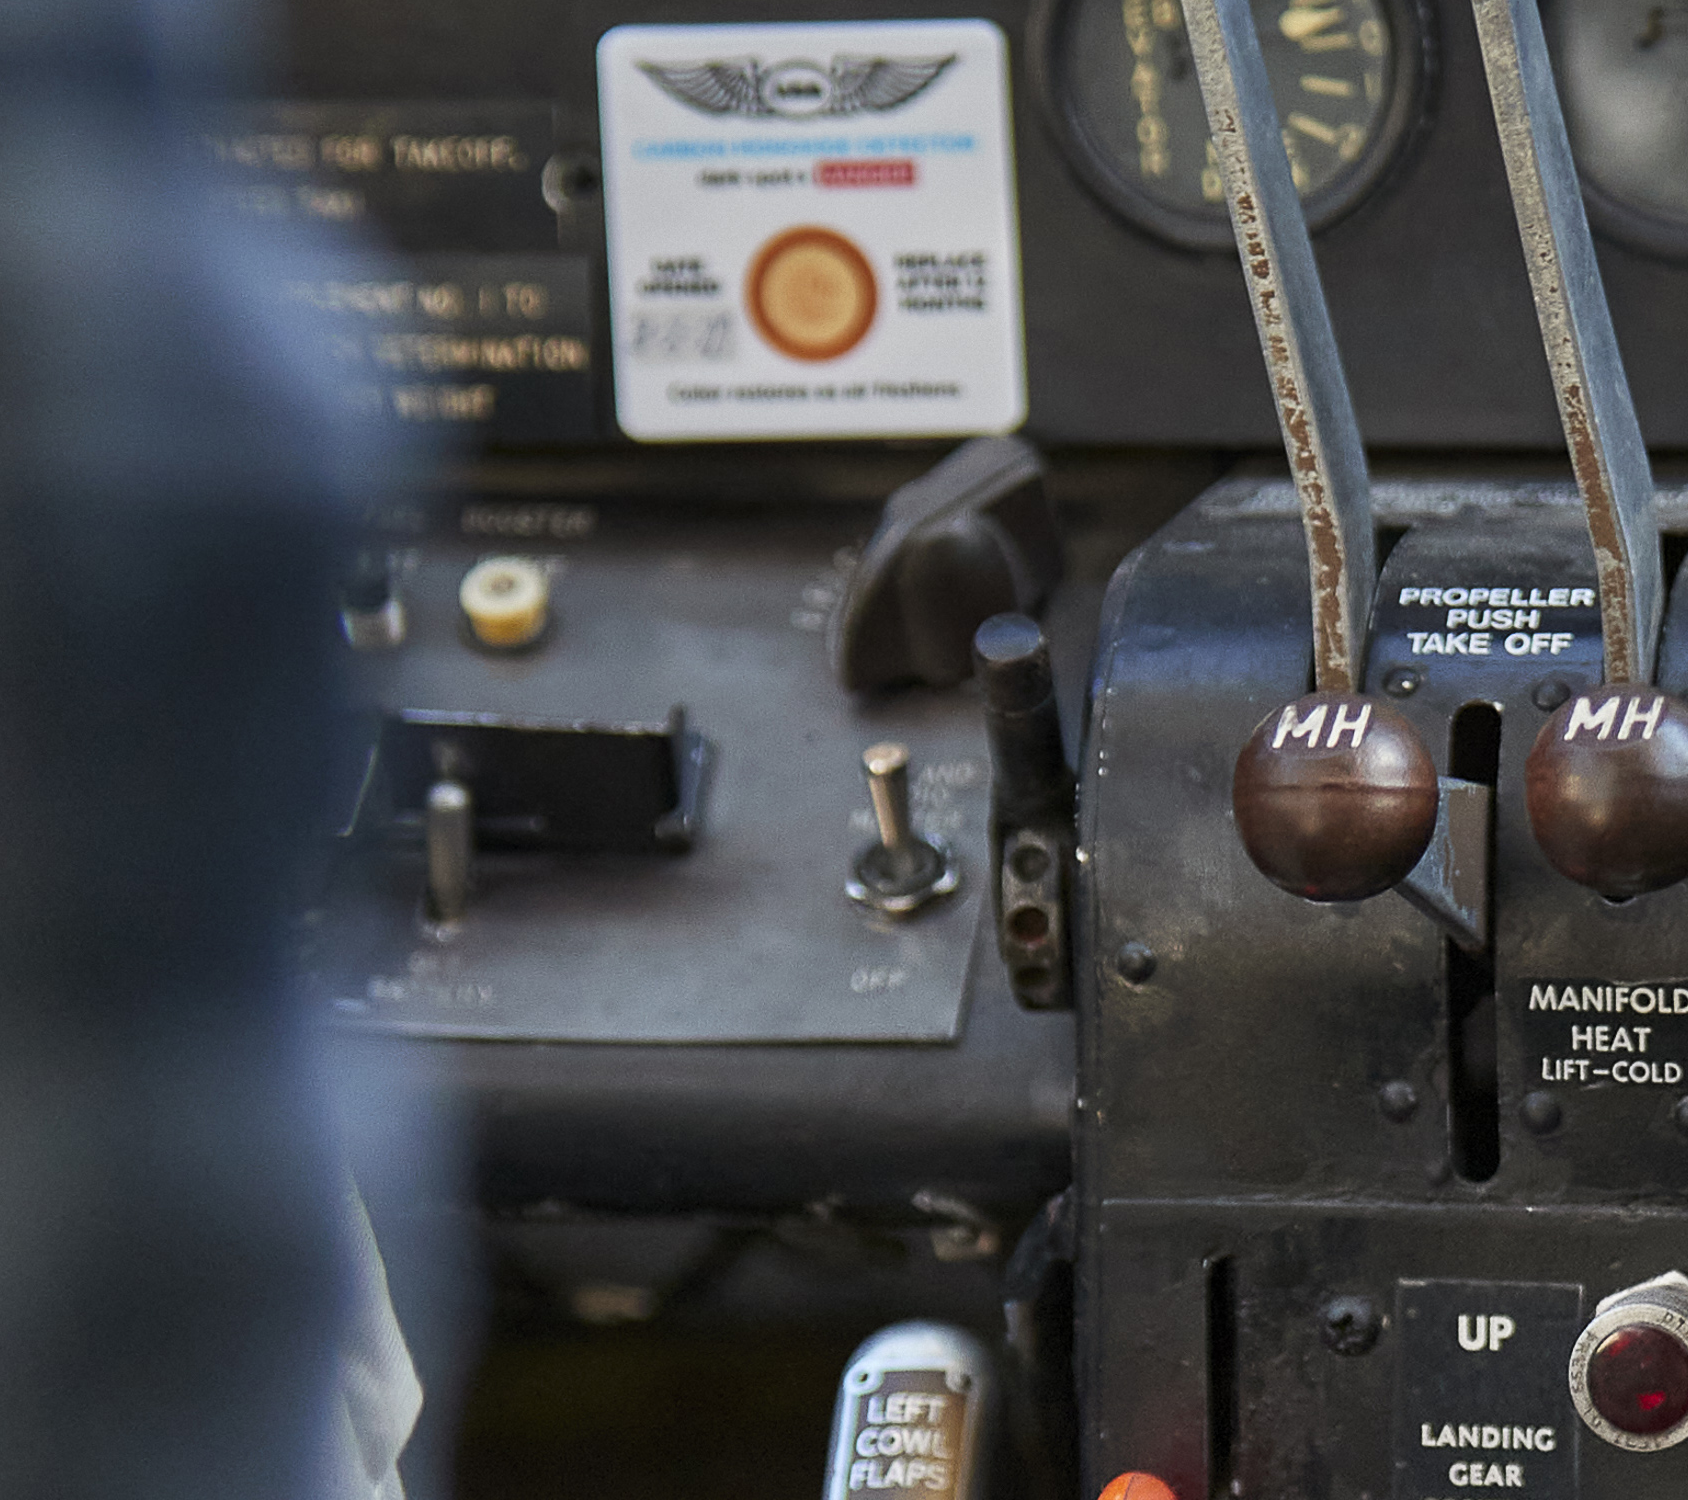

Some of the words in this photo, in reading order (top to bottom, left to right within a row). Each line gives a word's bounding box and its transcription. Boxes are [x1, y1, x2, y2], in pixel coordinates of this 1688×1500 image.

[1399, 587, 1595, 607] PROPELLER
[1446, 610, 1540, 629] PUSH
[1406, 633, 1491, 654] TAKE
[1504, 633, 1574, 654] OFF
[1271, 704, 1372, 749] MH
[1564, 696, 1665, 741] MH
[1570, 1025, 1652, 1053] HEAT
[1457, 1315, 1515, 1351] UP
[867, 1394, 946, 1424] LEFT
[856, 1426, 949, 1459] COWL
[1421, 1424, 1556, 1451] LANDING
[849, 1459, 950, 1490] FLAPS
[1449, 1464, 1524, 1487] GEAR
